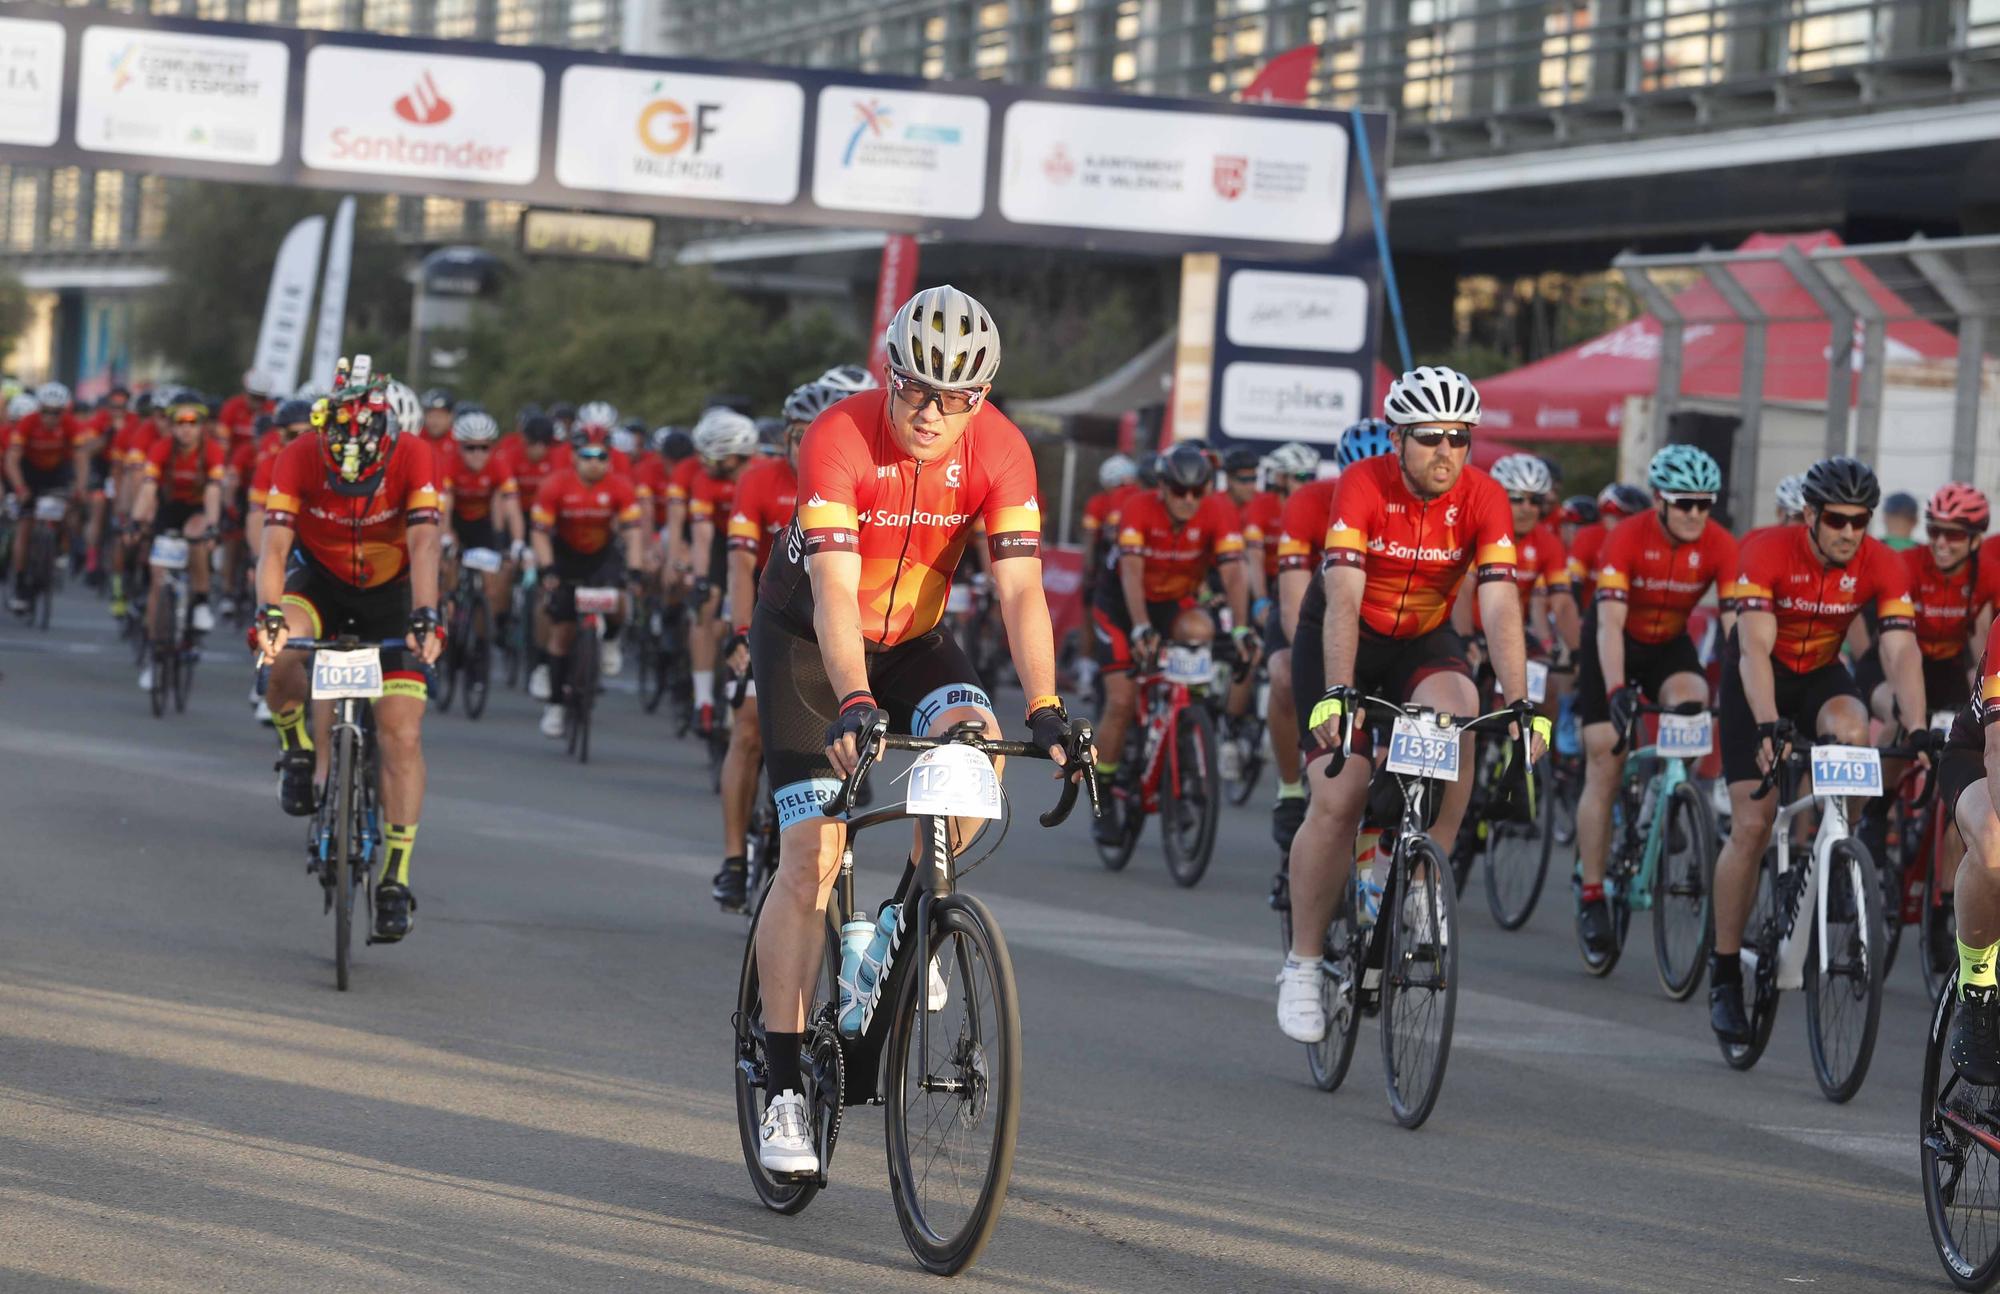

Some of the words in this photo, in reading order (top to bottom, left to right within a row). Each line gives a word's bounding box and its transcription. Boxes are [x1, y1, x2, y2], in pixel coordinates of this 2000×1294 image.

[330, 127, 511, 169] Santander
[1386, 541, 1463, 561] Santande
[1794, 597, 1861, 615] Santande
[319, 667, 367, 685] 1012
[918, 766, 982, 795] 128
[1819, 762, 1866, 780] 1719
[932, 814, 948, 880] IANT
